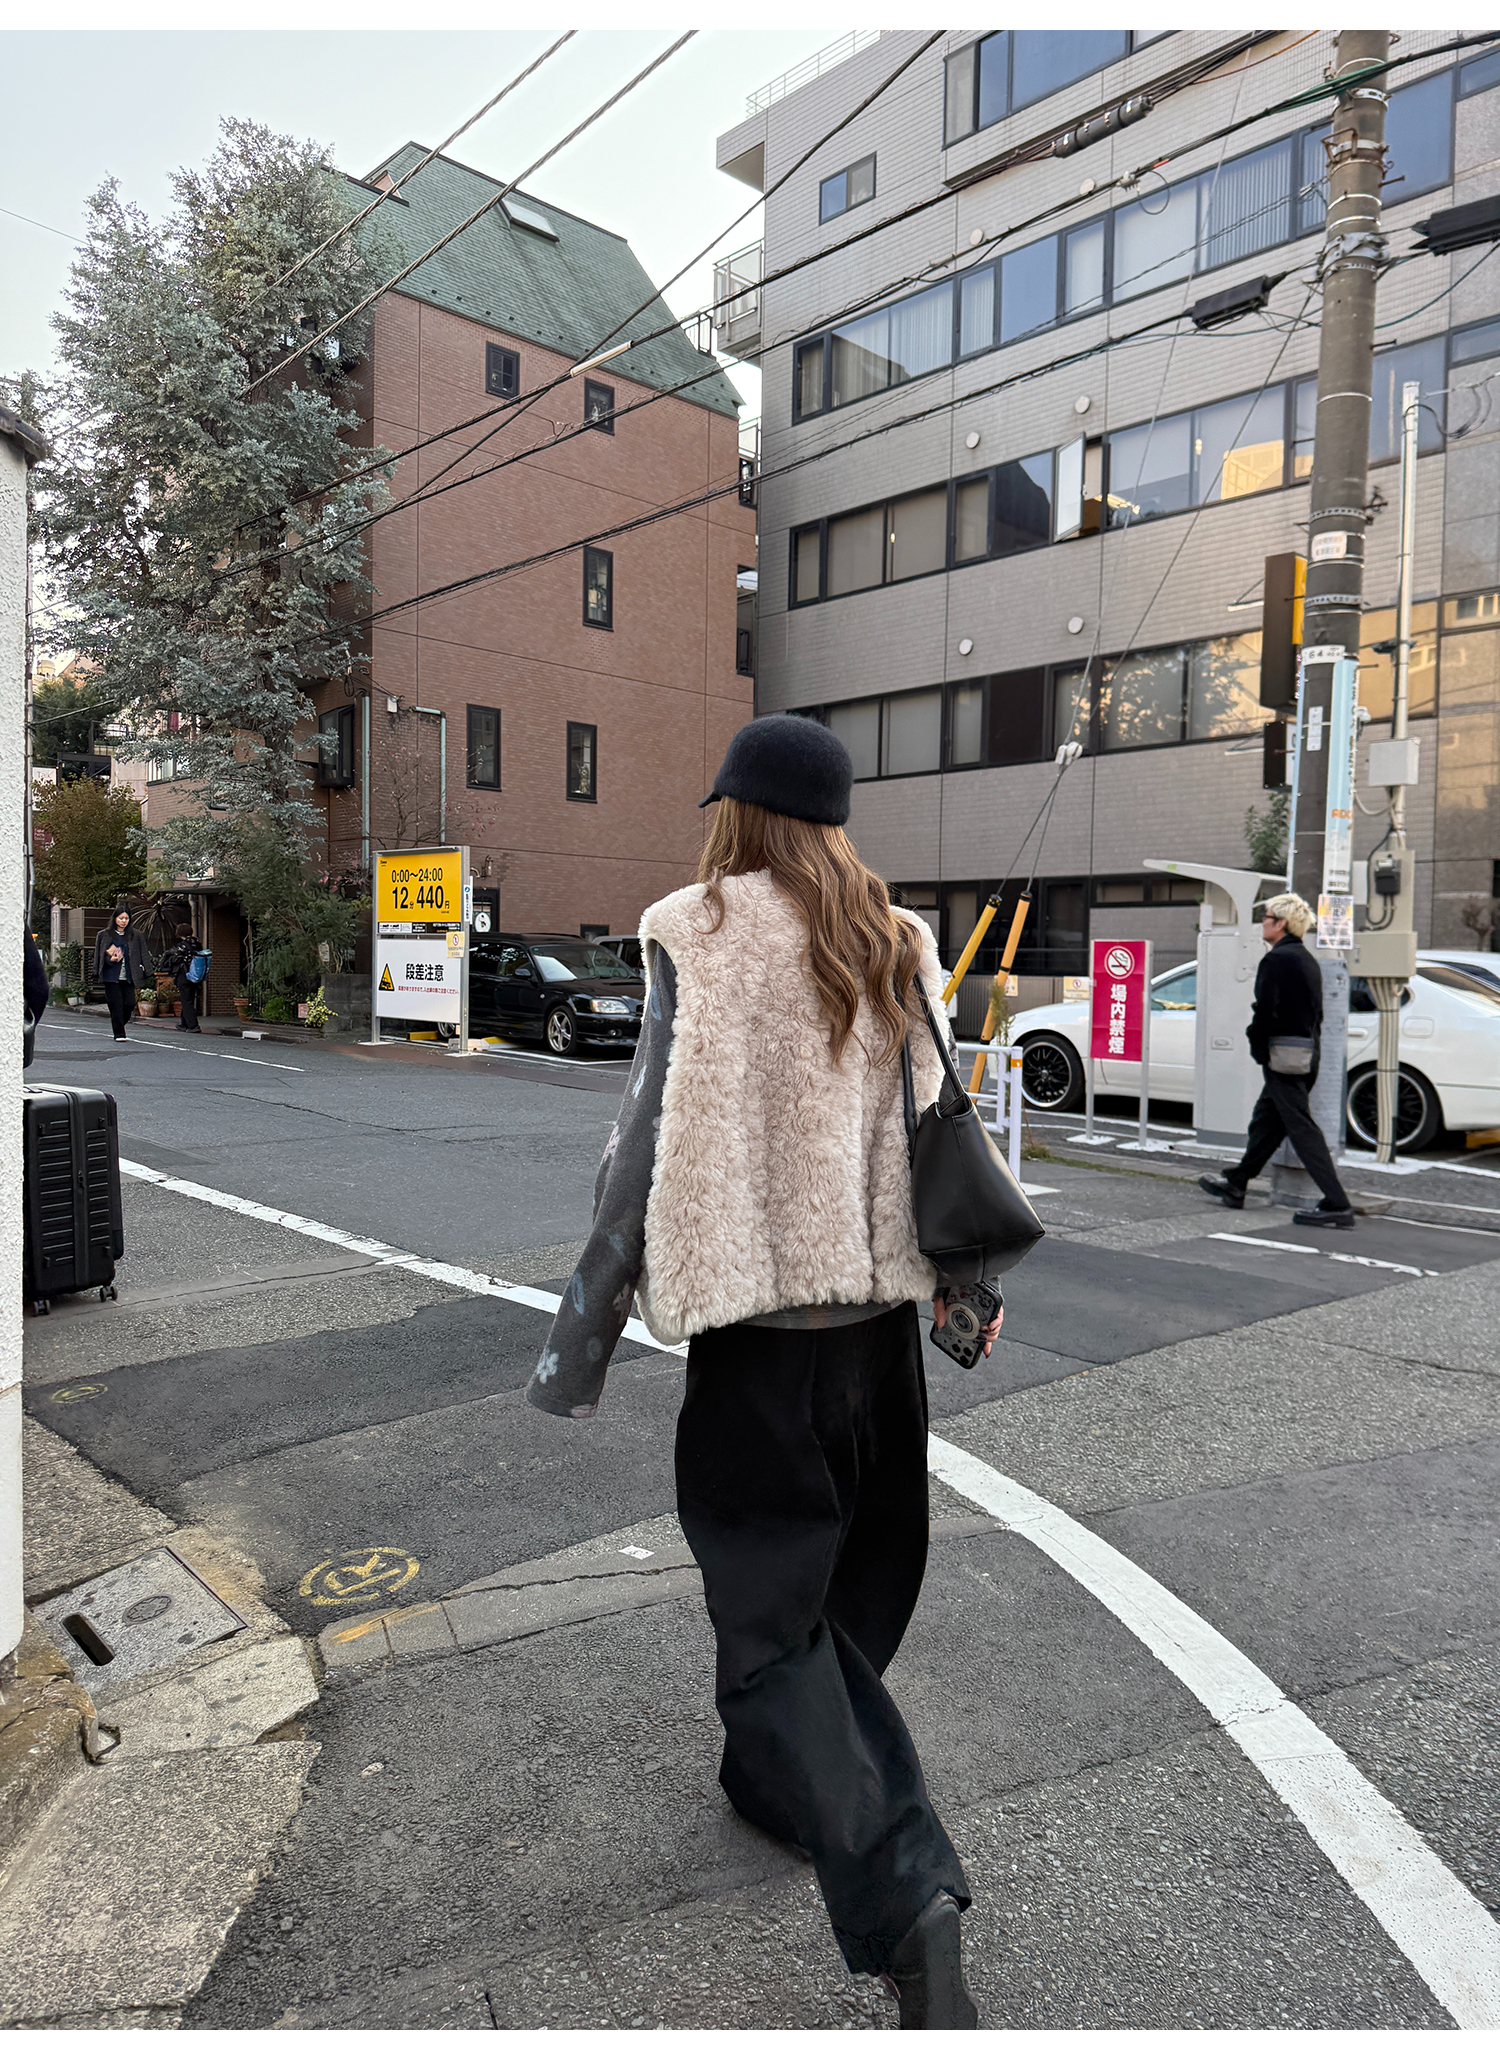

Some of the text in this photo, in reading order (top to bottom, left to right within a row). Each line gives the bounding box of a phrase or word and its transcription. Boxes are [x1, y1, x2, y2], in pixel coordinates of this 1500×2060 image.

[405, 963, 444, 982] 段差注意
[1108, 983, 1127, 1055] 場内禁煙
